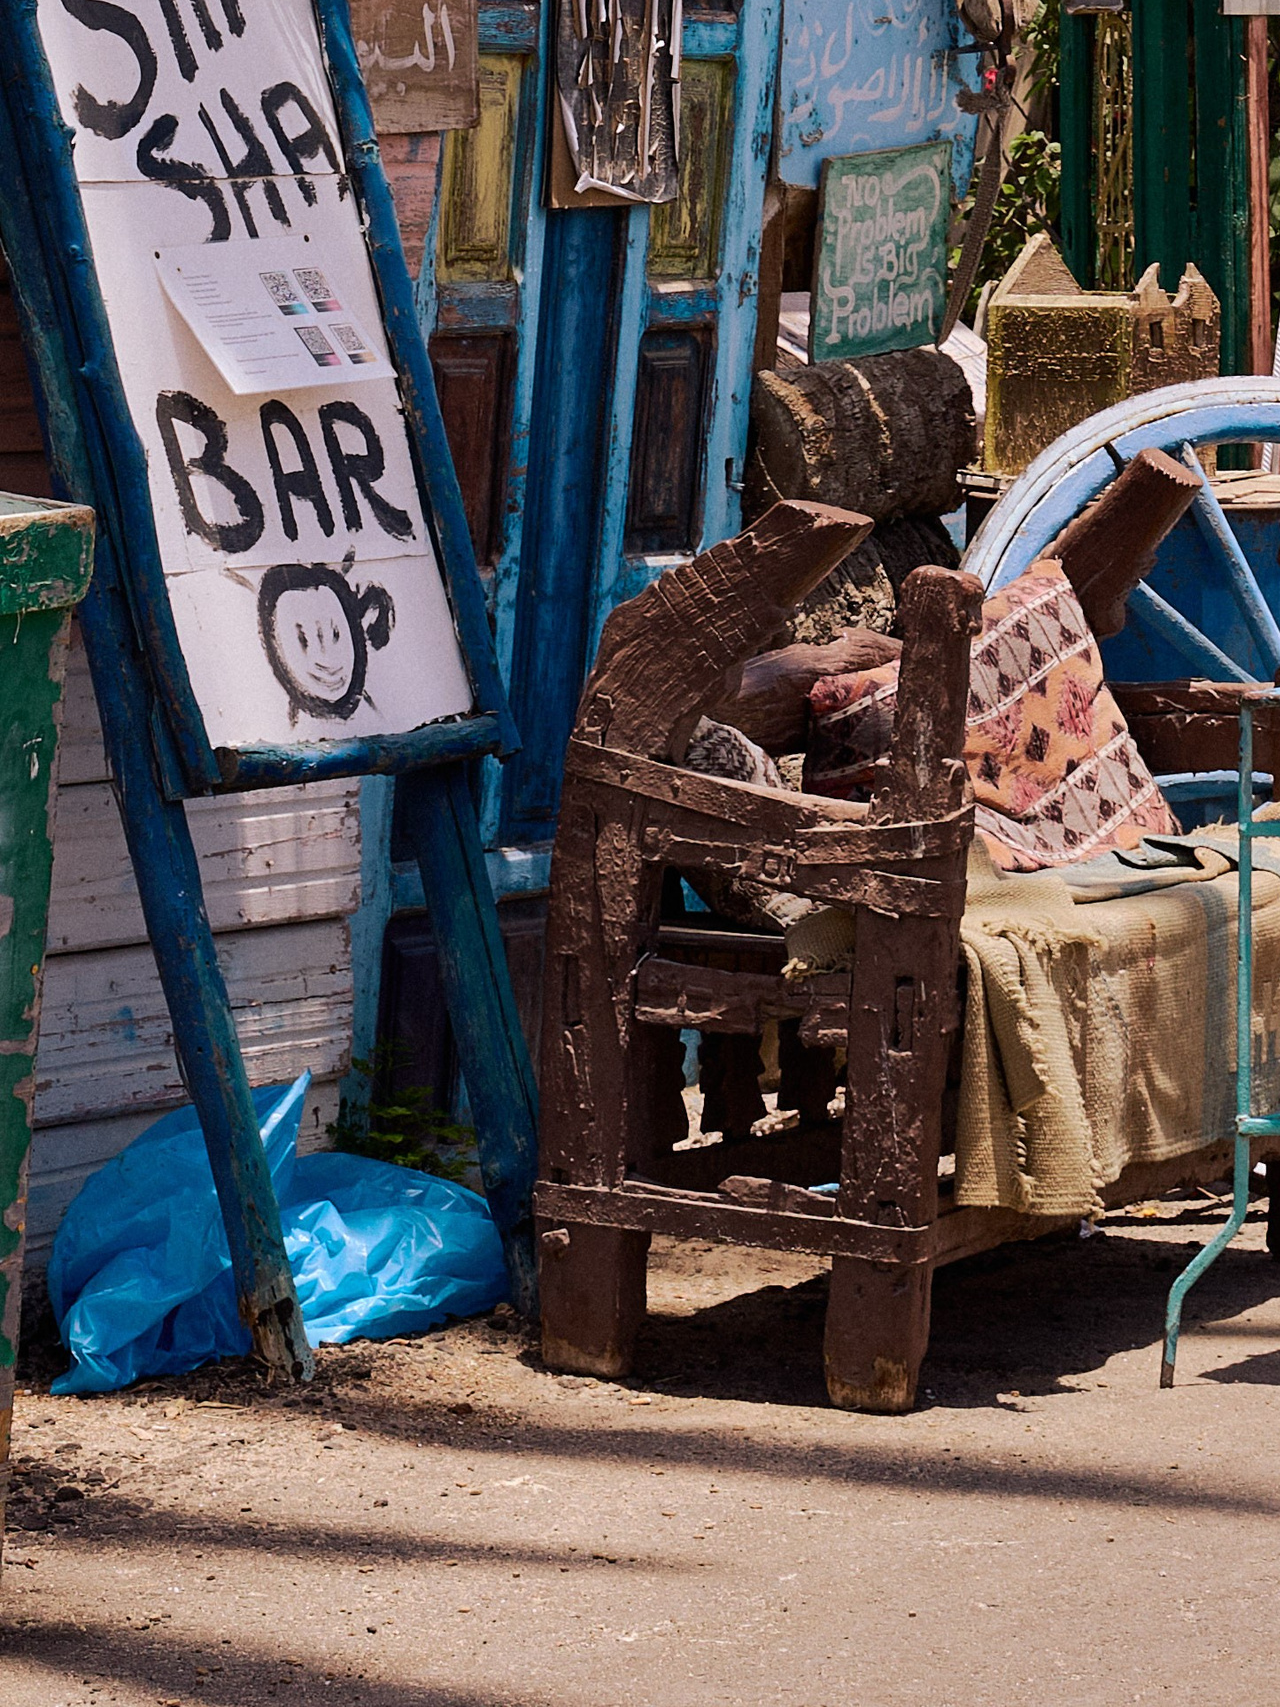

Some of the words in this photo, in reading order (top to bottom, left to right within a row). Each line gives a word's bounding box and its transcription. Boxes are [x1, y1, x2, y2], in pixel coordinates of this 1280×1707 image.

[137, 81, 349, 242] SHA
[832, 197, 926, 277] Problem
[824, 268, 937, 344] Problem
[156, 390, 416, 552] BAR
